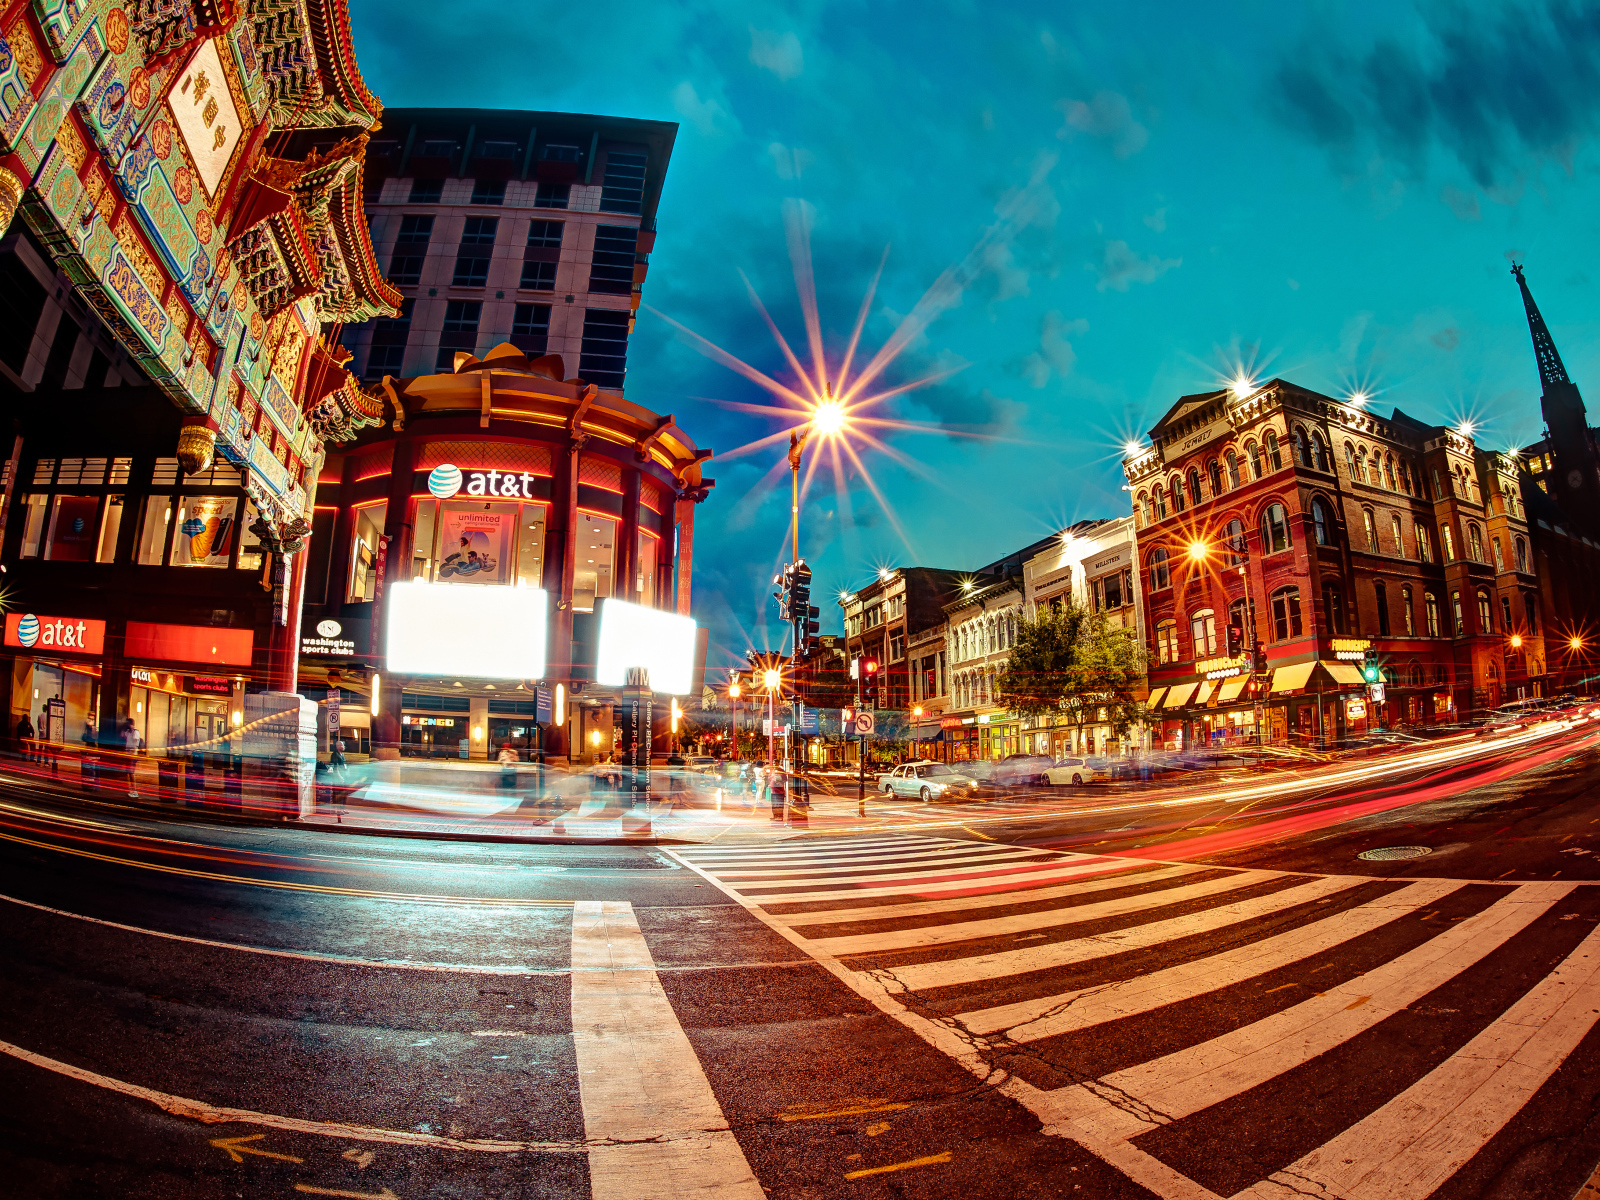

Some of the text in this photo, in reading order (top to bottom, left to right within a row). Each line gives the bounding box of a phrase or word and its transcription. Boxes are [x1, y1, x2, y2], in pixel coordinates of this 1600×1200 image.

[467, 469, 534, 498] at&t
[192, 505, 224, 516] speed
[458, 514, 500, 523] unlimited
[42, 619, 86, 648] at&t
[302, 638, 354, 647] washington
[302, 646, 354, 655] sports clubs
[410, 717, 455, 727] ZENGO
